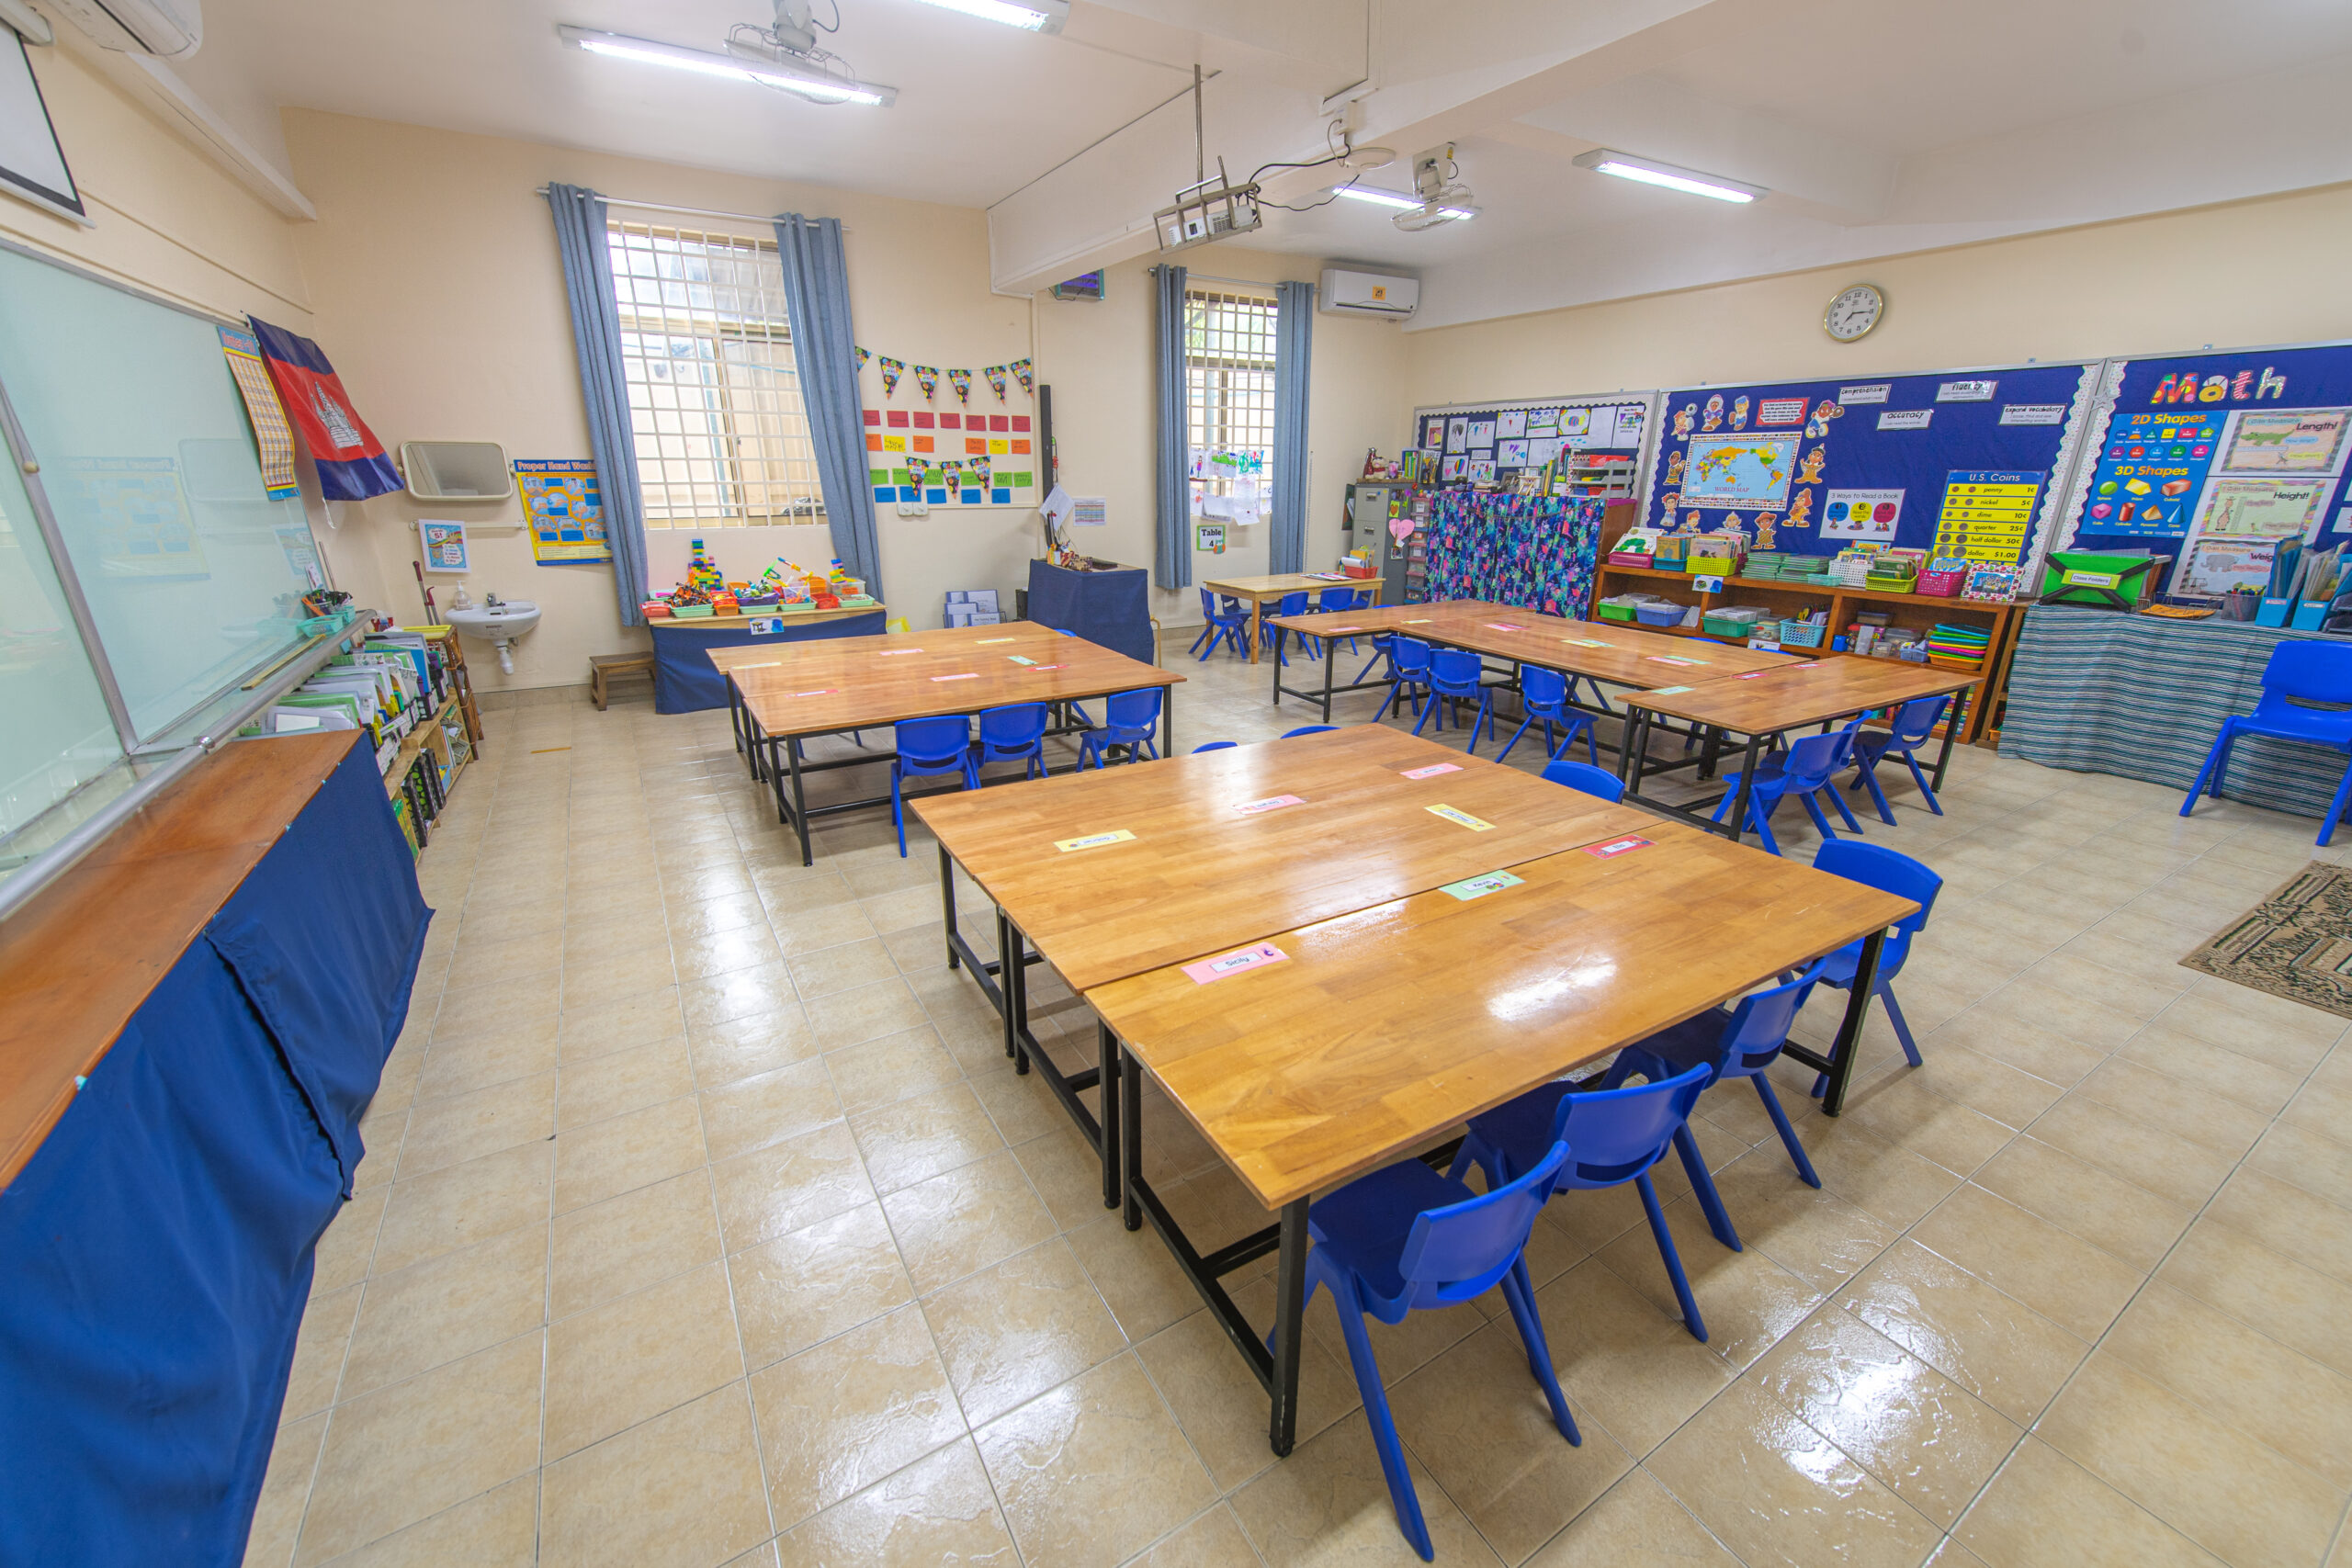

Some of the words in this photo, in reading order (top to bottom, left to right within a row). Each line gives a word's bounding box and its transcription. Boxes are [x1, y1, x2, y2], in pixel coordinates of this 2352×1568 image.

[2150, 367, 2287, 404] Math
[1841, 387, 1887, 396] comprehension
[2131, 414, 2151, 424] 2D
[2154, 413, 2207, 425] Shapes
[2296, 422, 2337, 432] Length!
[517, 461, 546, 471] Proper
[2114, 466, 2134, 475] 3D
[2137, 465, 2189, 478] Shapes
[1969, 473, 1986, 481] U.S.
[2273, 491, 2310, 501] Height!
[1209, 539, 1214, 547] 4
[2251, 553, 2273, 561] Weig
[1225, 957, 1250, 966] Sicily
